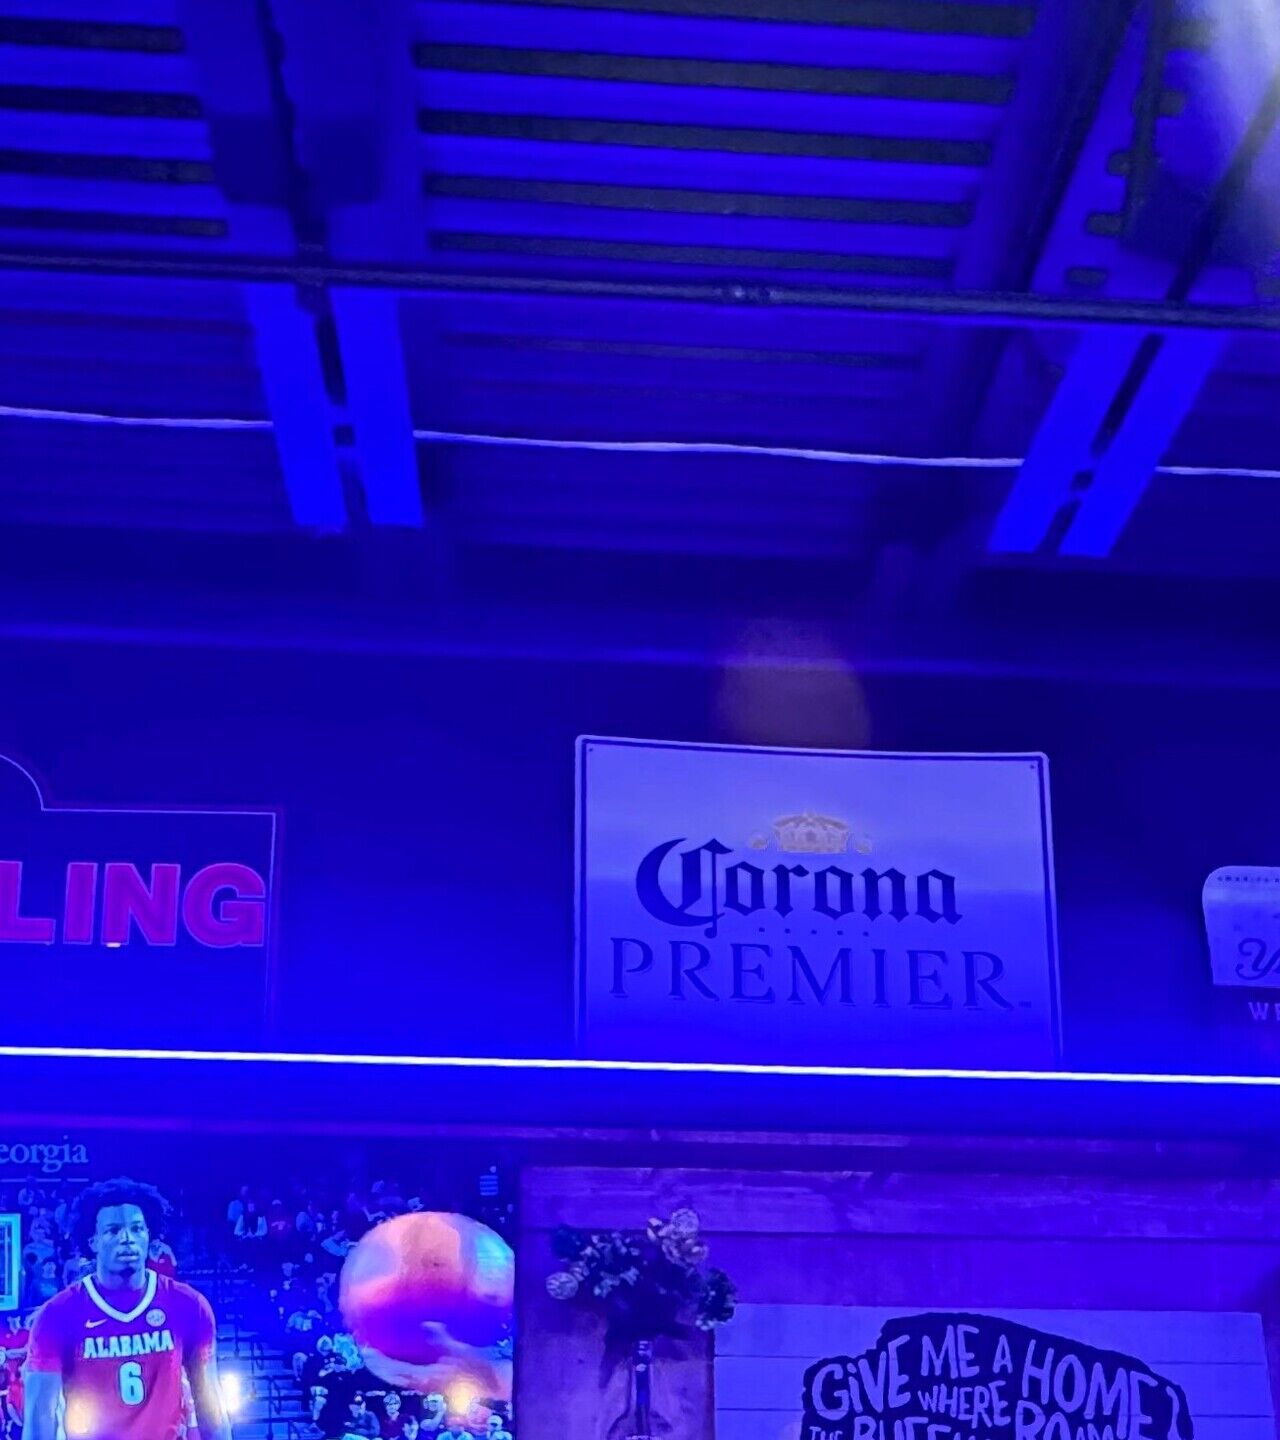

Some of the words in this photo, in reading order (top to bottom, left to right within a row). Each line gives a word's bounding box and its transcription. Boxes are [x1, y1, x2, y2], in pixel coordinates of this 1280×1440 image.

[635, 837, 963, 938] Corona
[82, 1329, 175, 1359] ALABAMA
[921, 1324, 980, 1379] ME
[993, 1333, 1013, 1374] A
[119, 1361, 144, 1406] 6
[918, 1380, 1011, 1429] WHERE
